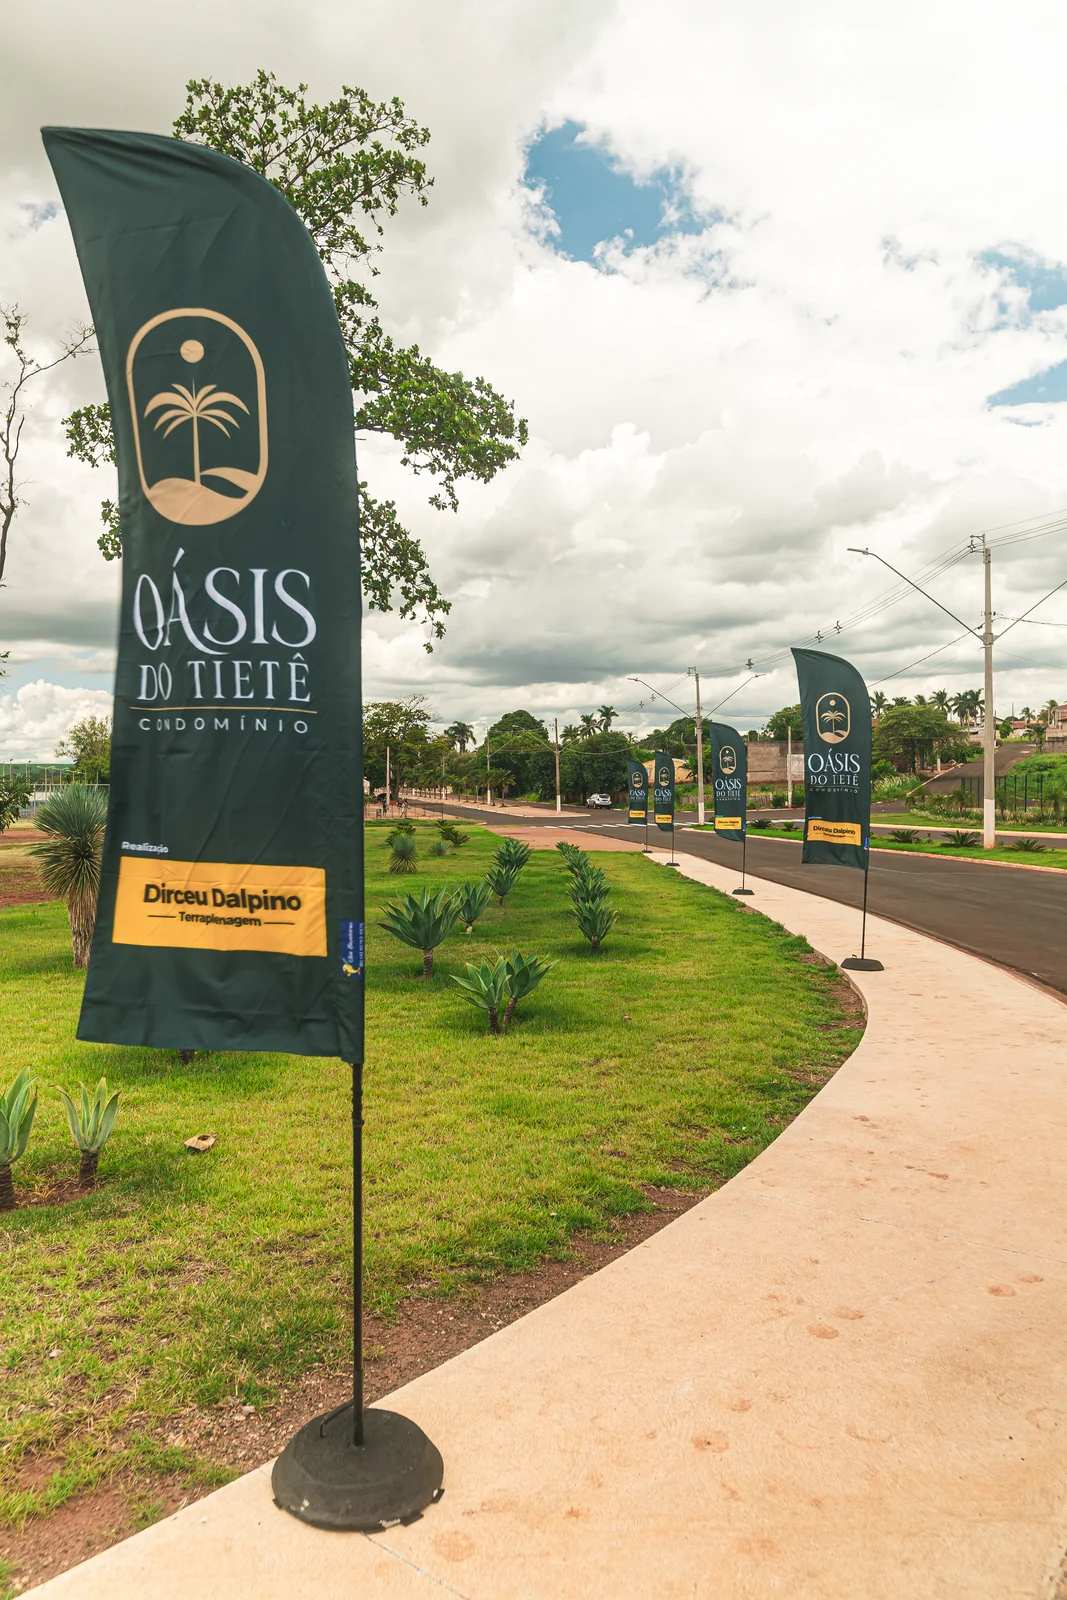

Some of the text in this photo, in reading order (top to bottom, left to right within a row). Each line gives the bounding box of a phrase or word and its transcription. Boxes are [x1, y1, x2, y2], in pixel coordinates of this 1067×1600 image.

[133, 547, 317, 656] OÁSIS
[137, 652, 311, 702] DO TIETÊ
[139, 715, 308, 734] CONDOMÍNIO
[807, 748, 861, 774] OÁSIS
[715, 776, 742, 791] OÁSIS
[810, 774, 859, 786] DO TIETÊ
[143, 882, 302, 914] Dirceu Dalpino
[178, 911, 262, 927] Terraplenagem
